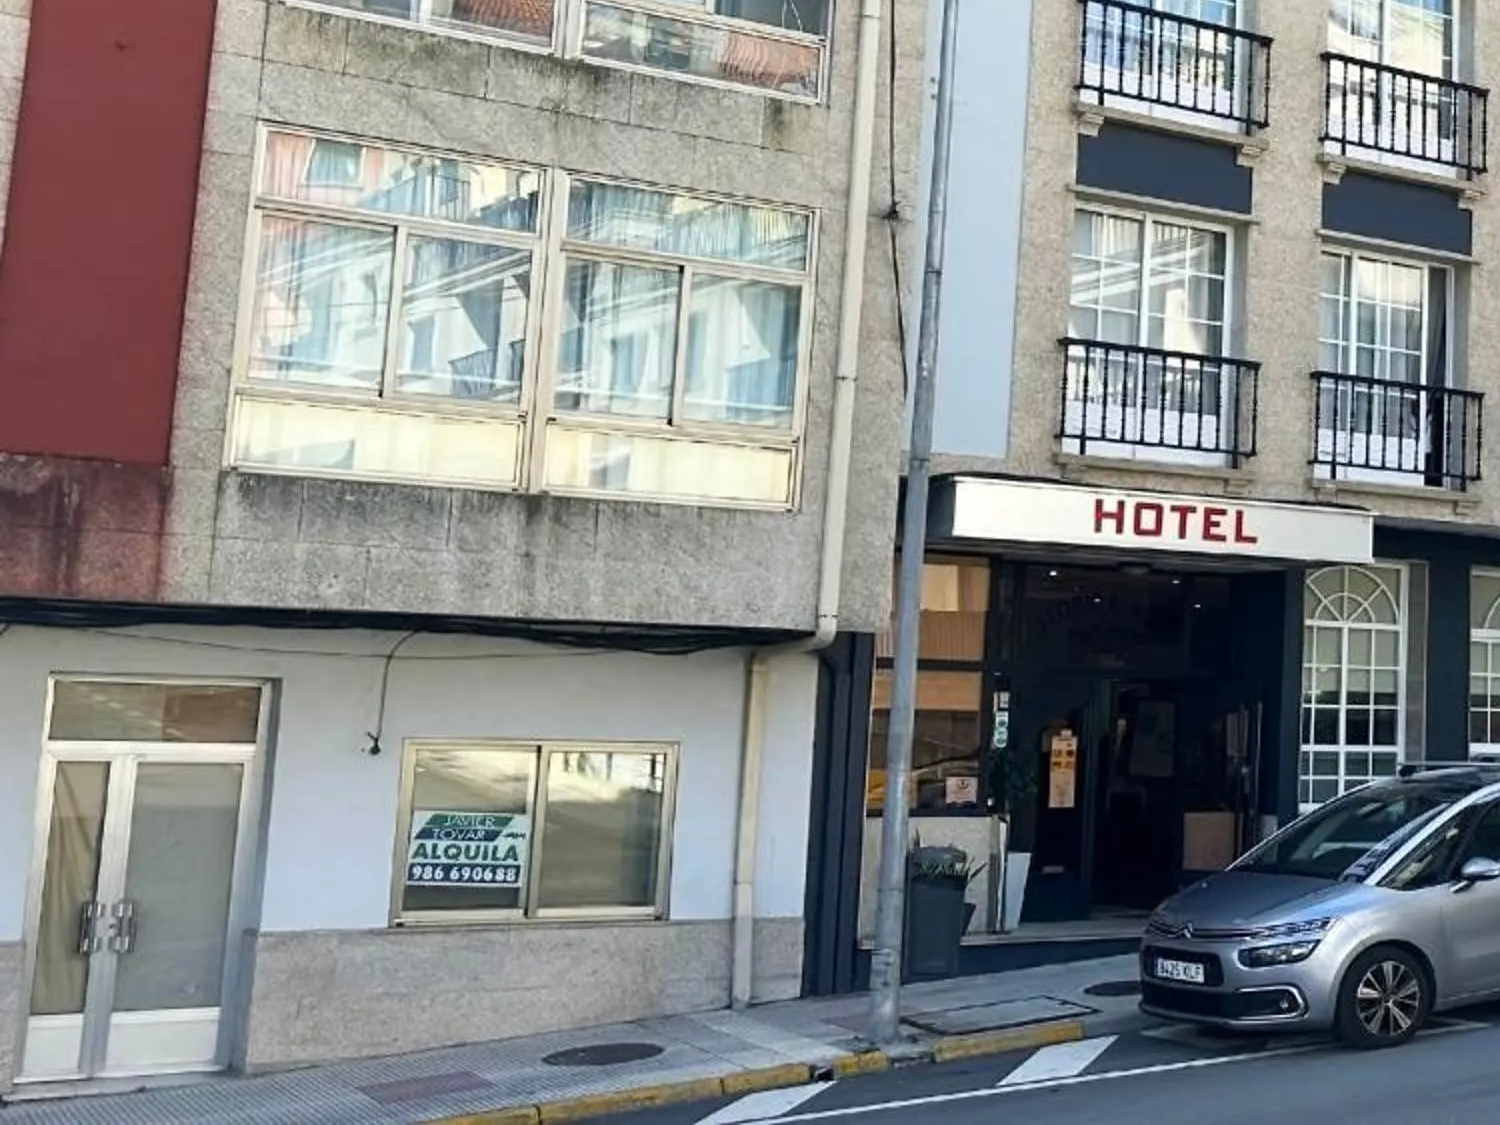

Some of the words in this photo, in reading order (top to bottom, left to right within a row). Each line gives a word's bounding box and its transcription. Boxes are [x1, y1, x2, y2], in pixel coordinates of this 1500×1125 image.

[1094, 498, 1258, 544] HOTEL
[432, 828, 486, 840] TOVAR
[411, 842, 519, 862] ALQUILA
[412, 864, 444, 879] 986
[449, 866, 517, 882] 690688
